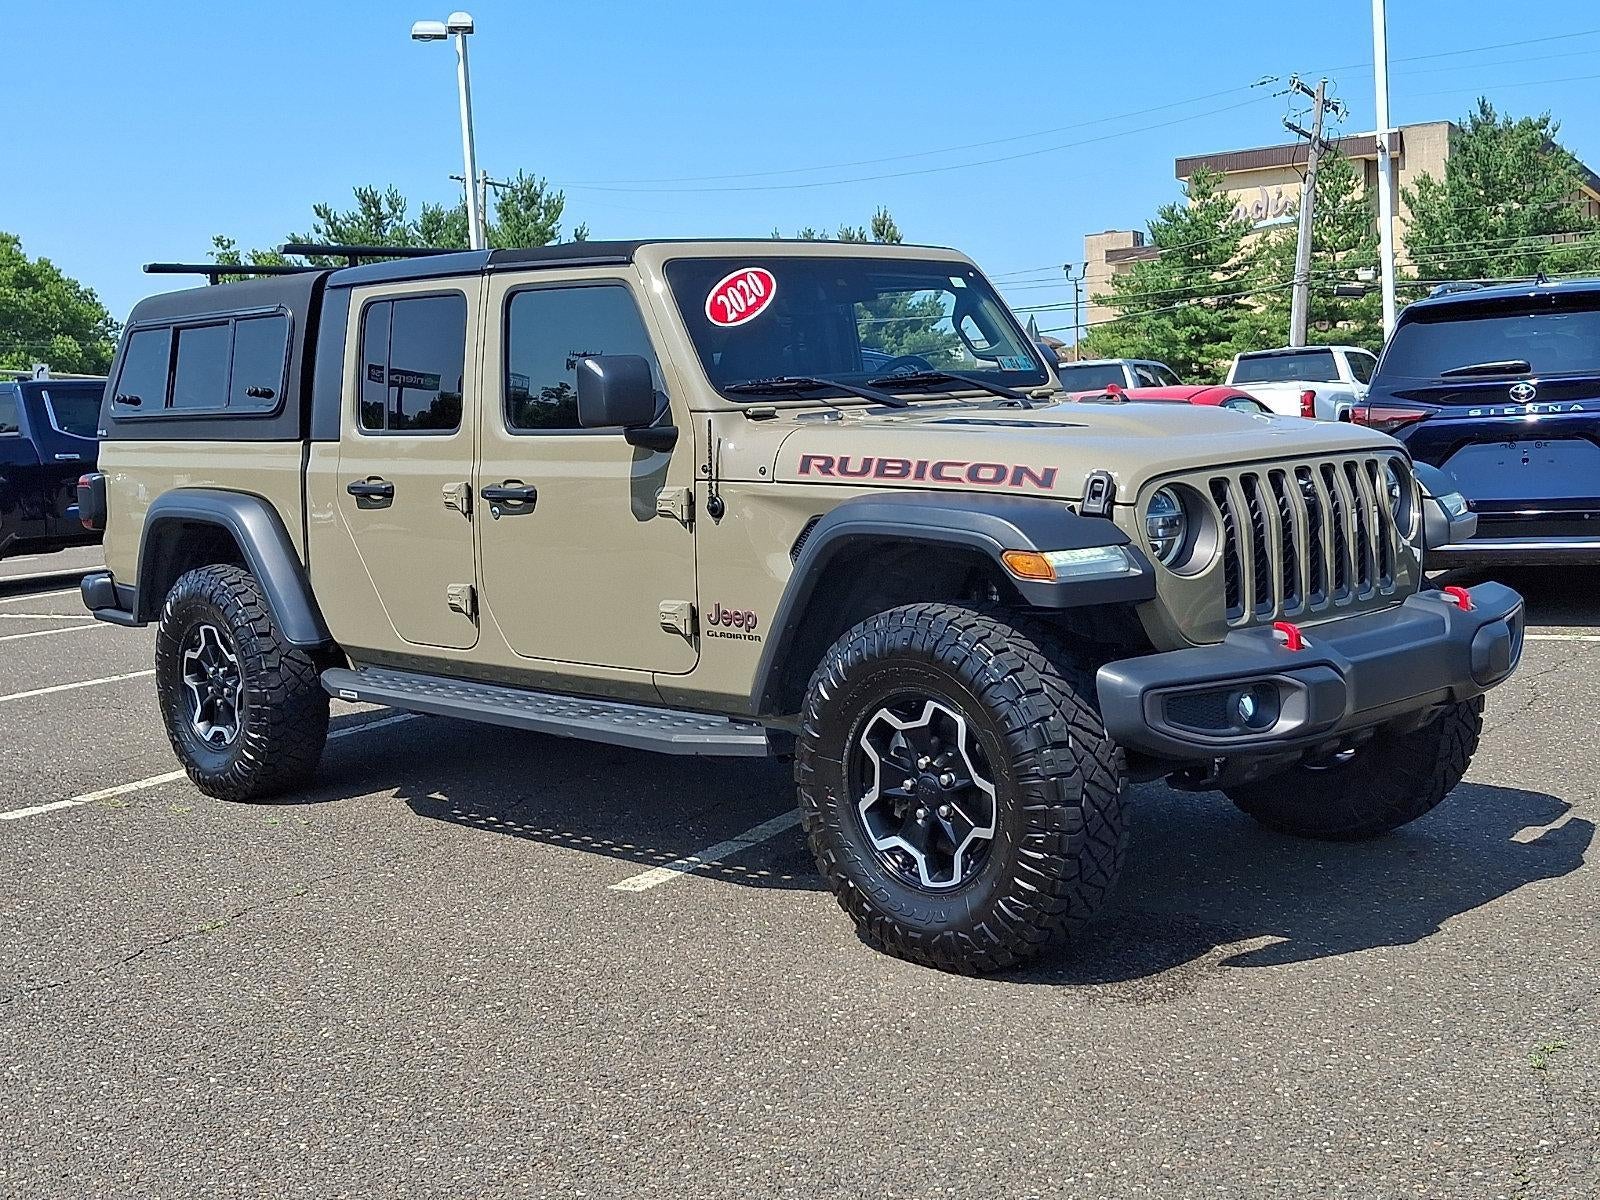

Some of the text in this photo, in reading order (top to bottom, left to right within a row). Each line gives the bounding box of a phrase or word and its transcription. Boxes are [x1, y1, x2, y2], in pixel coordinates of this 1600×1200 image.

[717, 271, 765, 322] 2020
[1467, 403, 1585, 416] SIENNA
[797, 453, 1060, 490] RUBICON
[706, 602, 758, 633] Jeep
[706, 630, 762, 642] GLADIATOR
